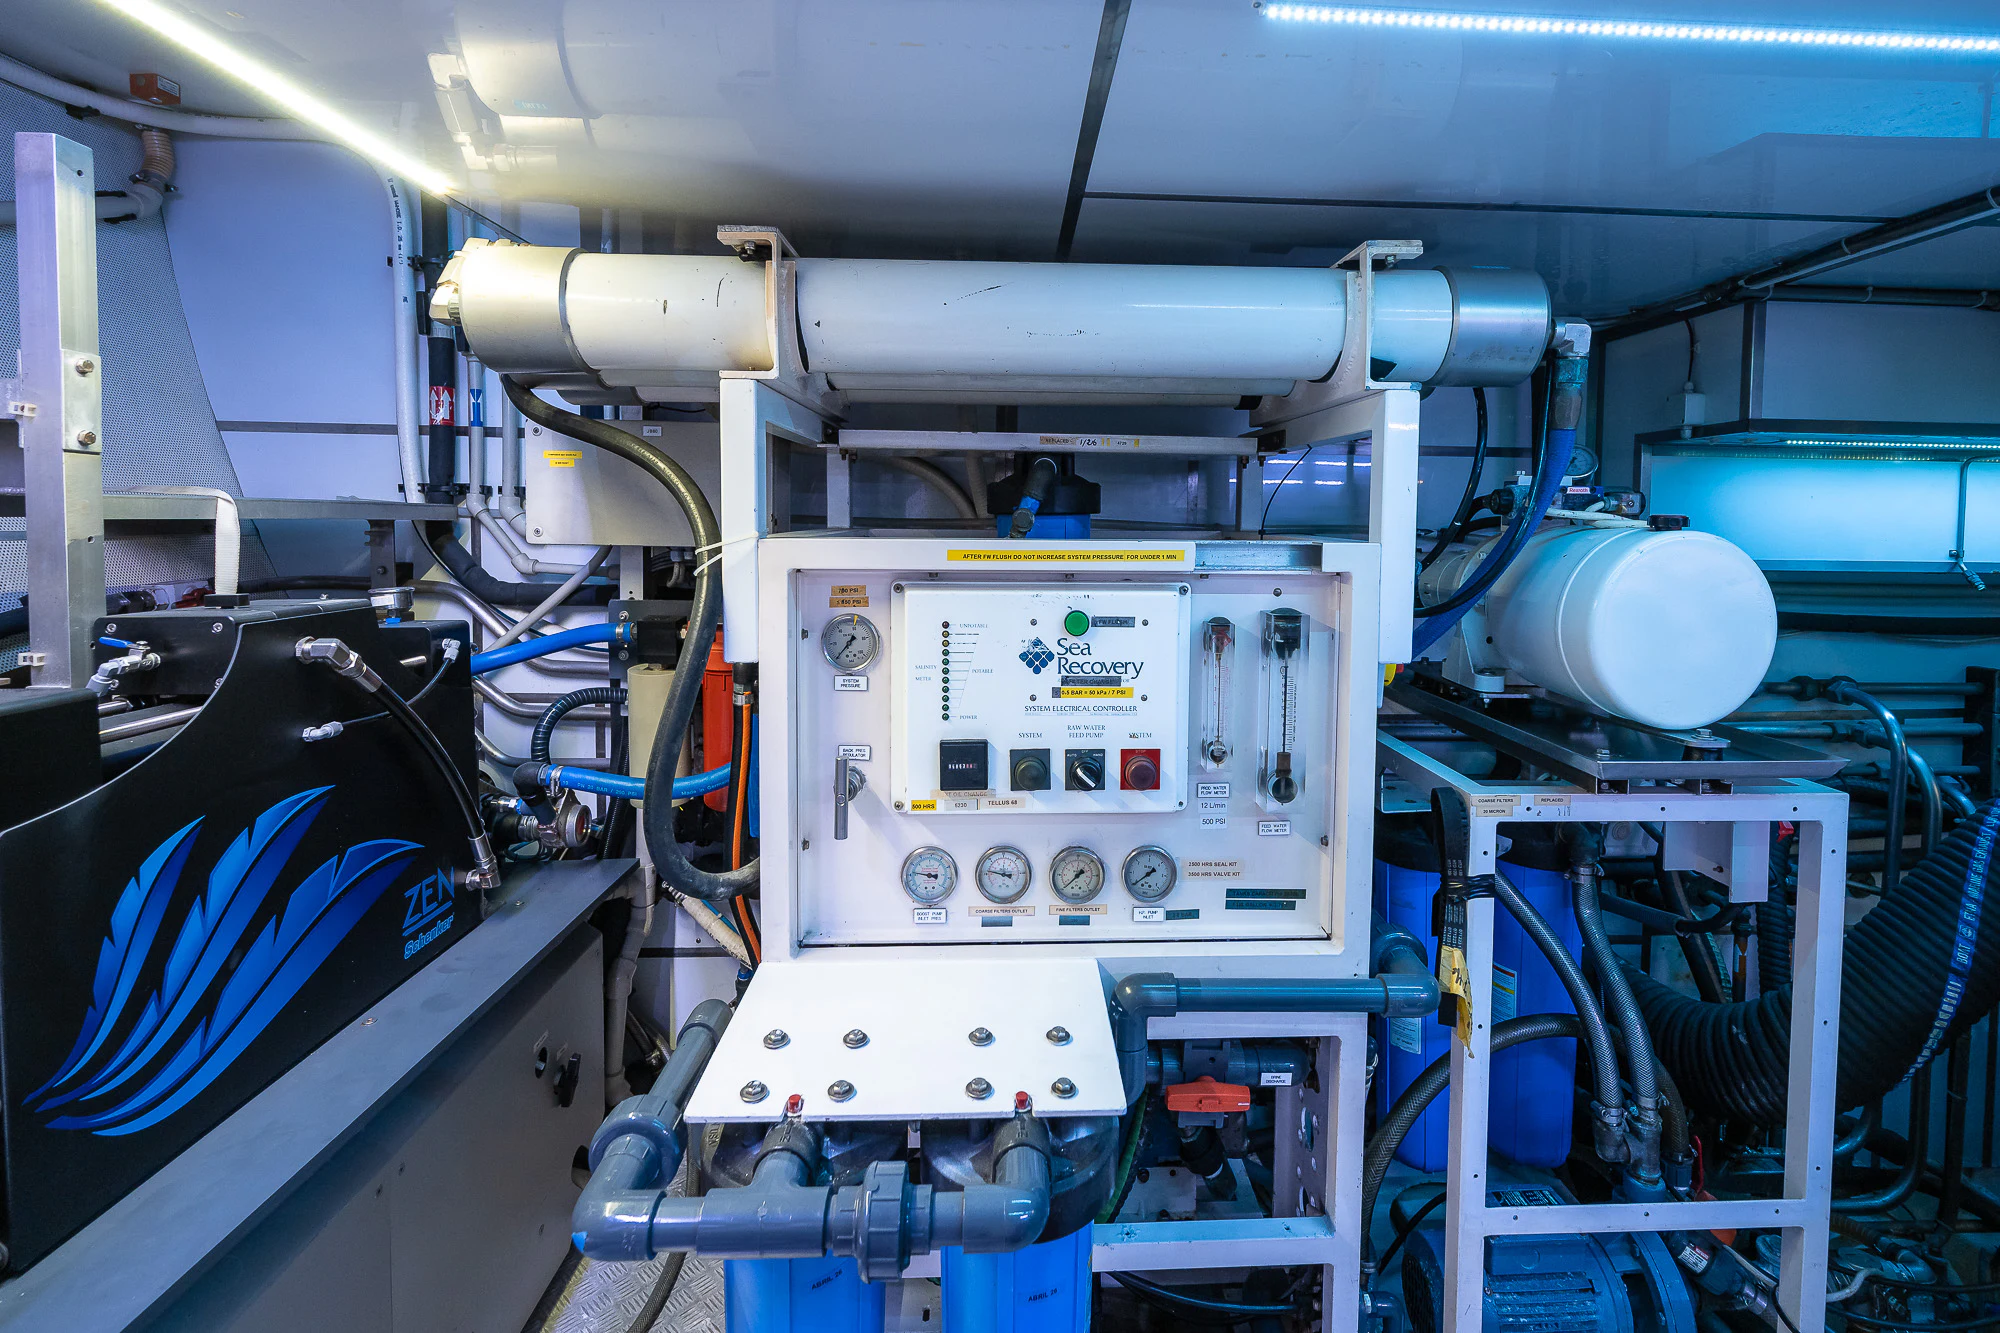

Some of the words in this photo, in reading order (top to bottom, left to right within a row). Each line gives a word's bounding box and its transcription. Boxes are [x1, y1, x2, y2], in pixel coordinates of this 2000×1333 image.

[1056, 638, 1092, 656] Sea
[1057, 657, 1144, 679] Recovery
[402, 866, 455, 929] ZEN
[404, 914, 454, 960] Schenker
[812, 1276, 833, 1290] ABRIL
[1028, 1292, 1048, 1302] ABRIL
